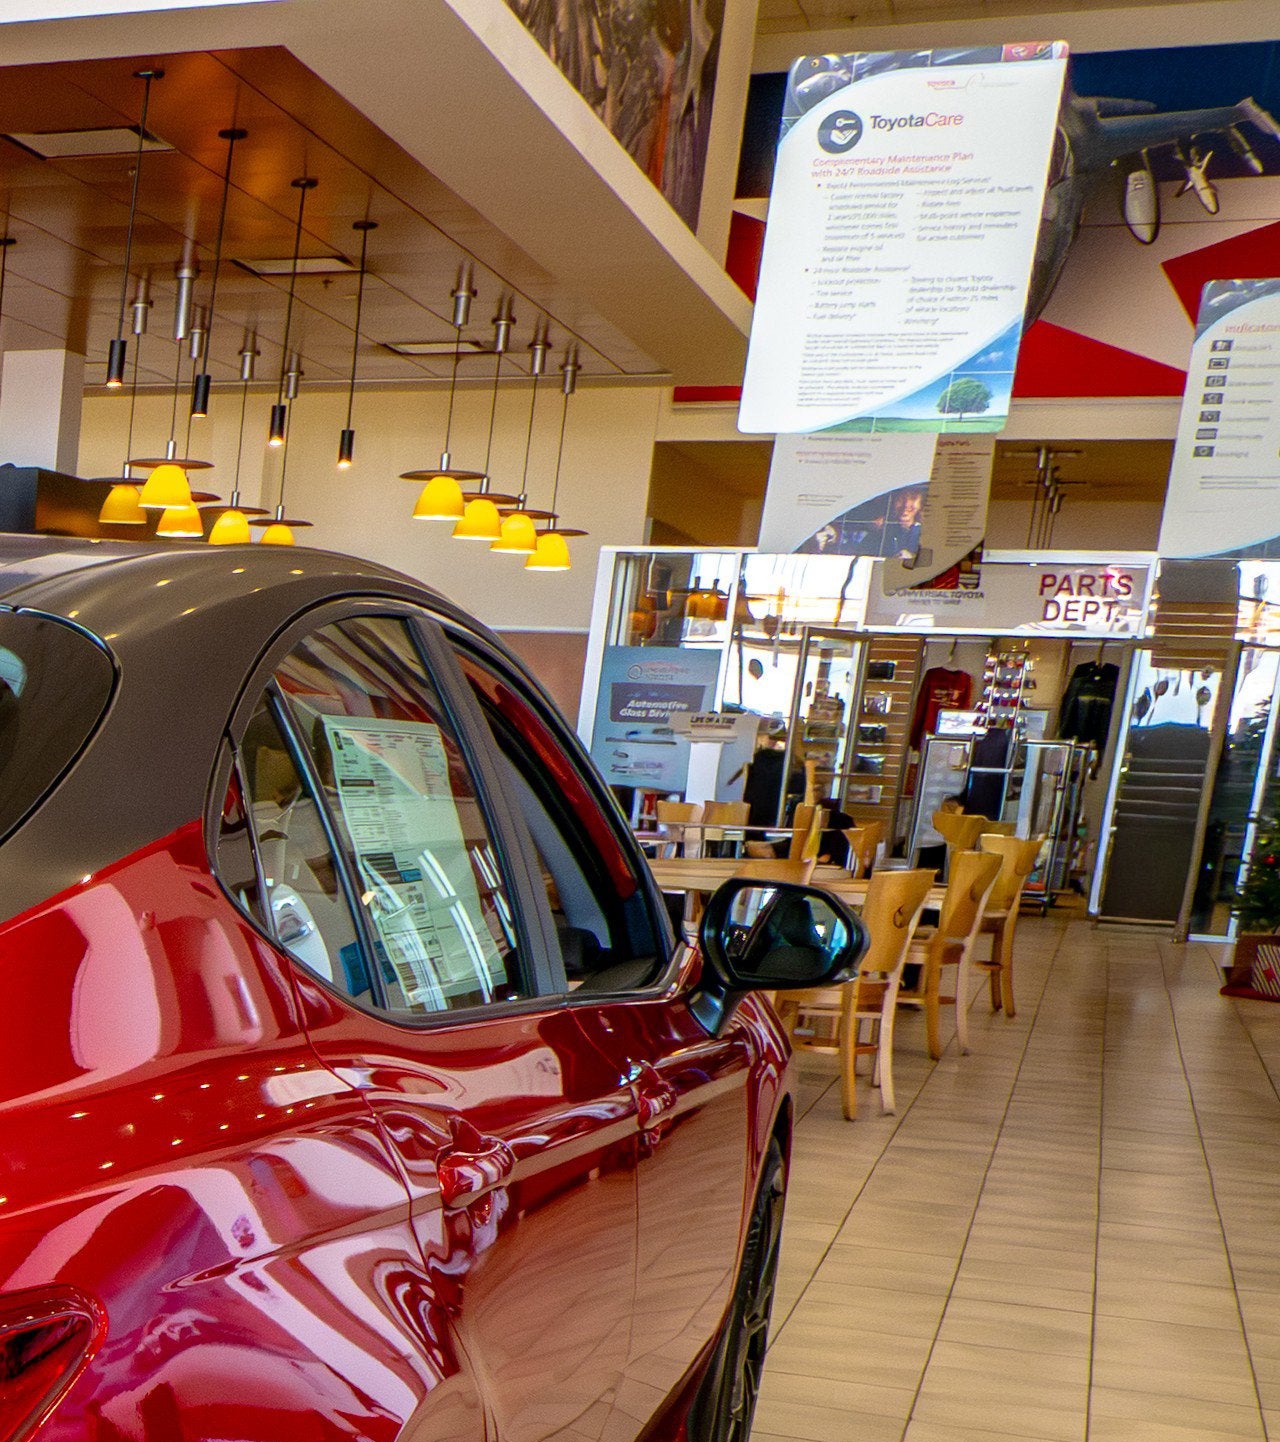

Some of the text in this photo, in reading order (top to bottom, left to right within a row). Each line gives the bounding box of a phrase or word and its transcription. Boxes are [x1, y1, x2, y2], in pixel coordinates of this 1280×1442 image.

[870, 112, 965, 132] ToyotaCare
[813, 151, 974, 167] Complimentary Maintenance Plan
[811, 164, 952, 177] with 24/7 Roadside Assistance
[1039, 574, 1133, 597] PARTS
[951, 591, 985, 599] TOYOTA
[627, 700, 689, 710] Automotive
[619, 708, 646, 718] Glass
[690, 716, 705, 724] LIFE
